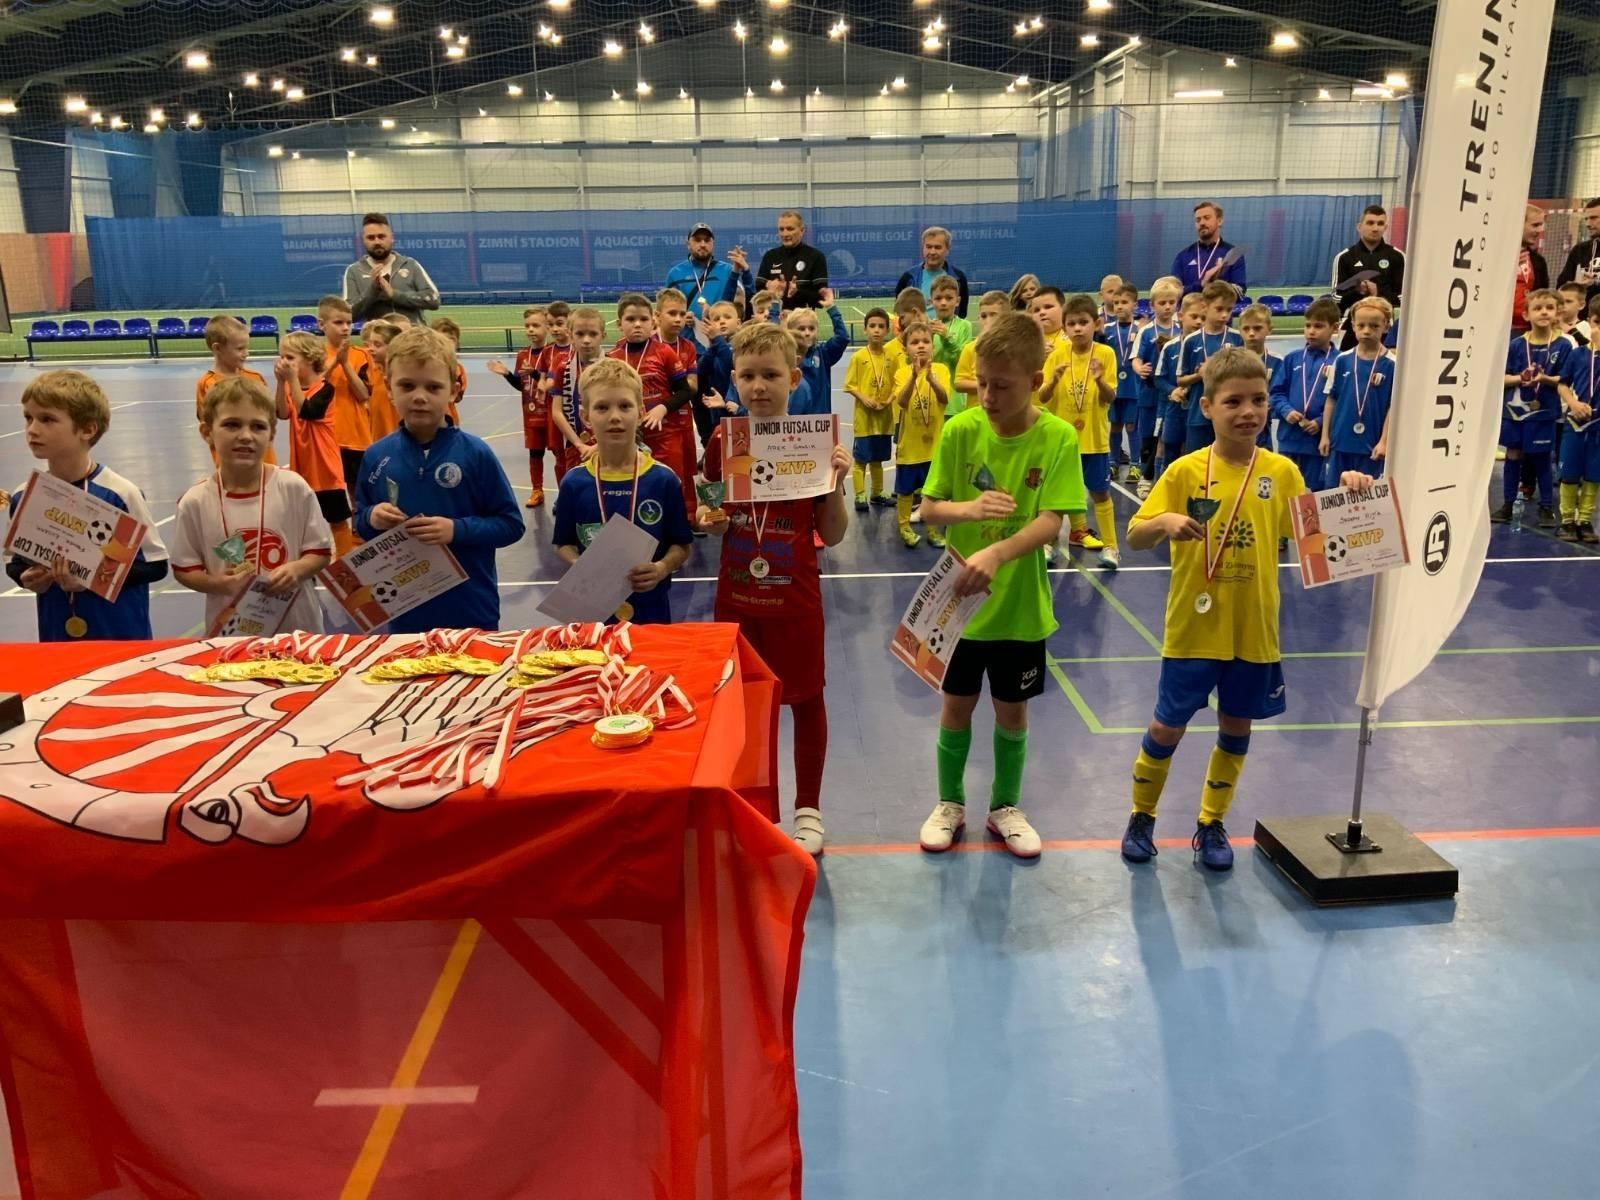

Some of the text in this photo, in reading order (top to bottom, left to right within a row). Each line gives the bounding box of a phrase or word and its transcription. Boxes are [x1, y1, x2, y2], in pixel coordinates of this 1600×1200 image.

[1473, 141, 1499, 301] MŁODEGO
[426, 239, 466, 249] STEZKA
[479, 235, 579, 248] ZIMNÍ STADION
[594, 235, 687, 248] AQUACENRU
[817, 230, 913, 243] ADVENTURE GOLF
[1432, 238, 1474, 456] JUNIOR
[754, 419, 831, 436] JUNIOR FUTSAL CUP
[776, 460, 816, 475] MVP
[1320, 484, 1389, 511] JUNIOR FUTSAL CUP
[44, 507, 88, 535] MVP
[13, 536, 32, 553] CUP
[1346, 527, 1384, 549] MVP
[33, 543, 65, 563] UTSAL
[350, 545, 379, 568] JUNIOR
[376, 530, 408, 553] FUTSAL
[69, 560, 91, 580] JUNIO
[391, 559, 431, 587] MVP
[906, 598, 925, 627] JUNIOR
[921, 571, 943, 602] FUTSAL
[939, 555, 954, 575] CUP
